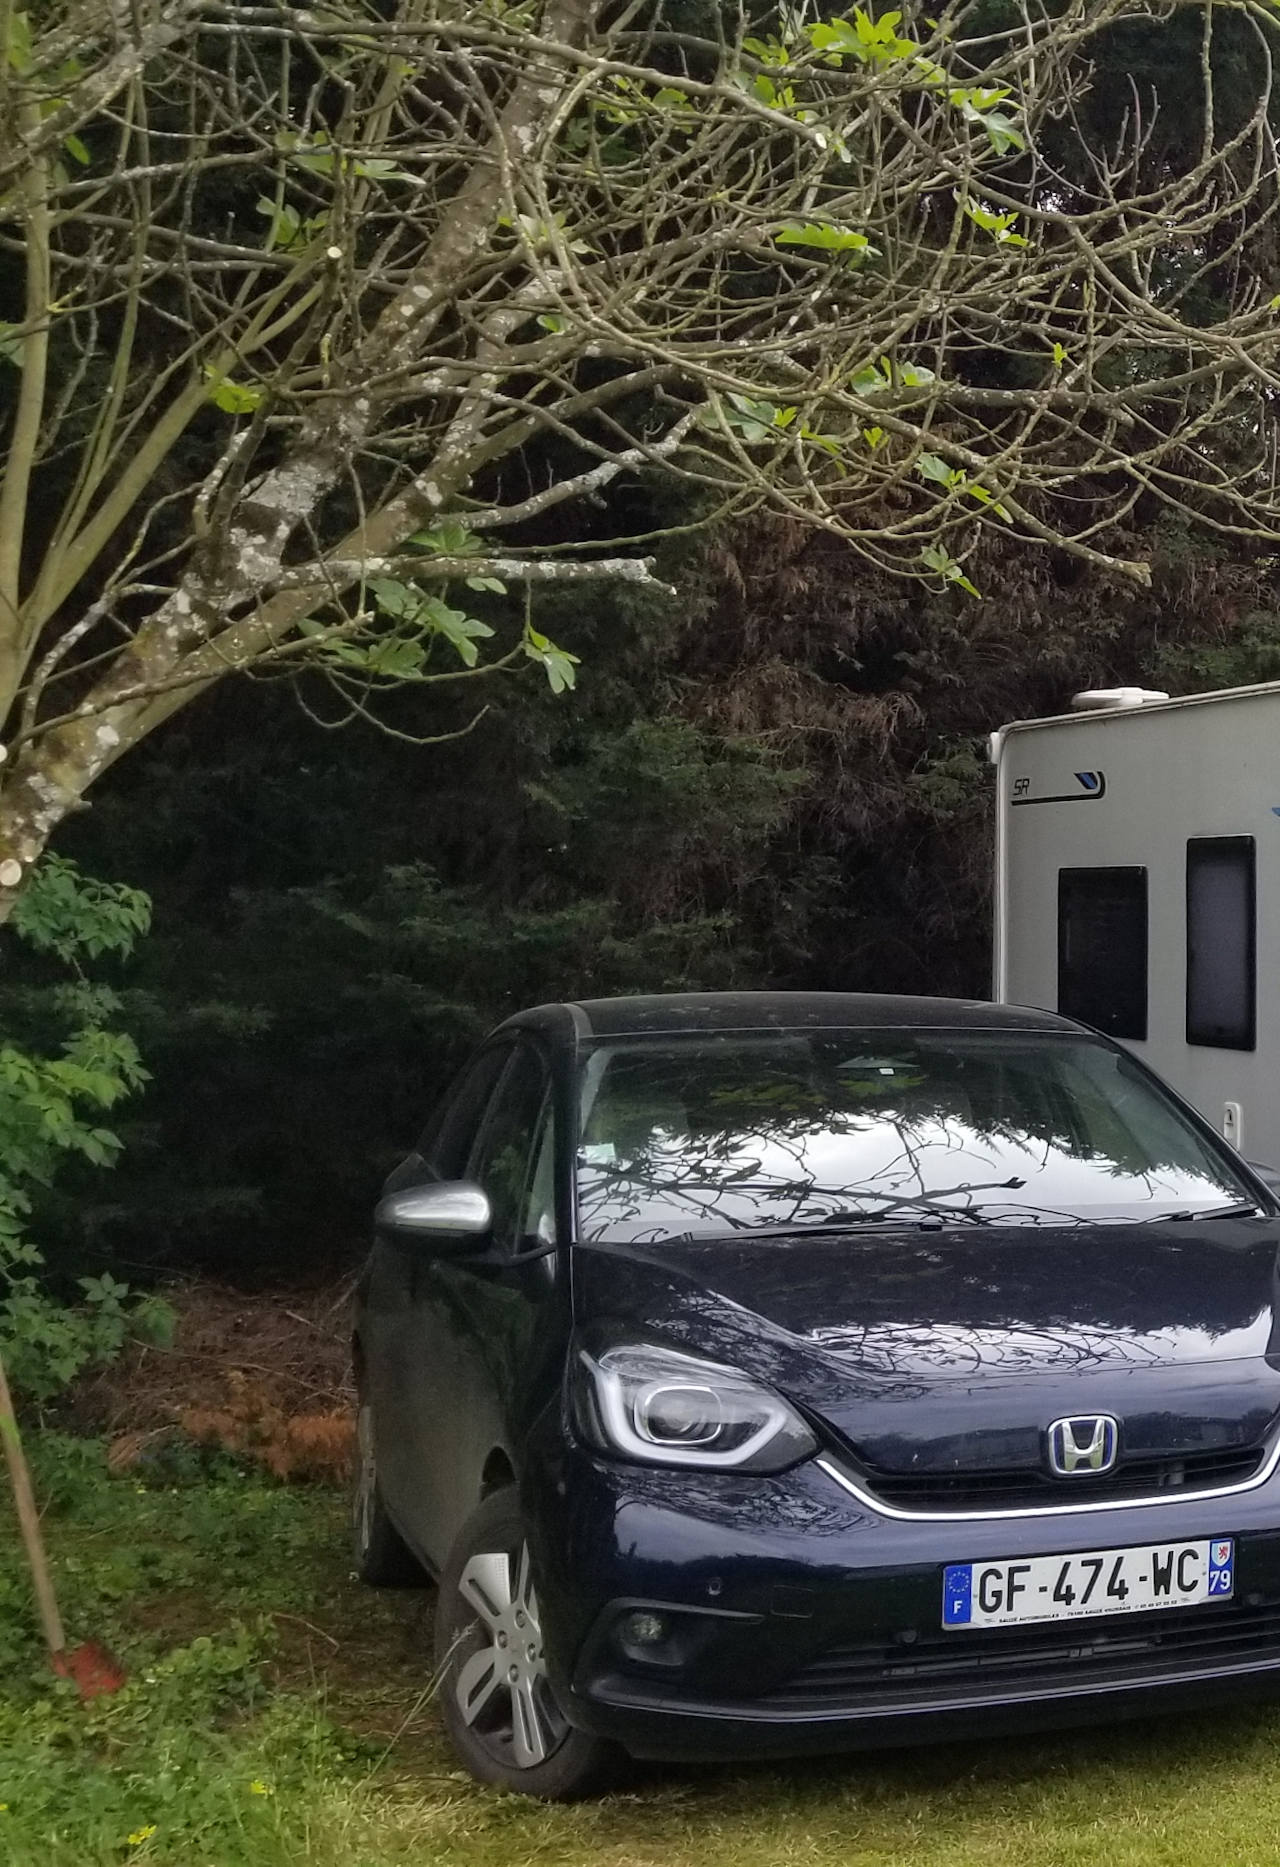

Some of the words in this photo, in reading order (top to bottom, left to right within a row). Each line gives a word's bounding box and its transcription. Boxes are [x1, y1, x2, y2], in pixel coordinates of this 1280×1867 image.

[1012, 778, 1030, 796] SR
[952, 1600, 964, 1614] F
[1208, 1570, 1231, 1592] 79
